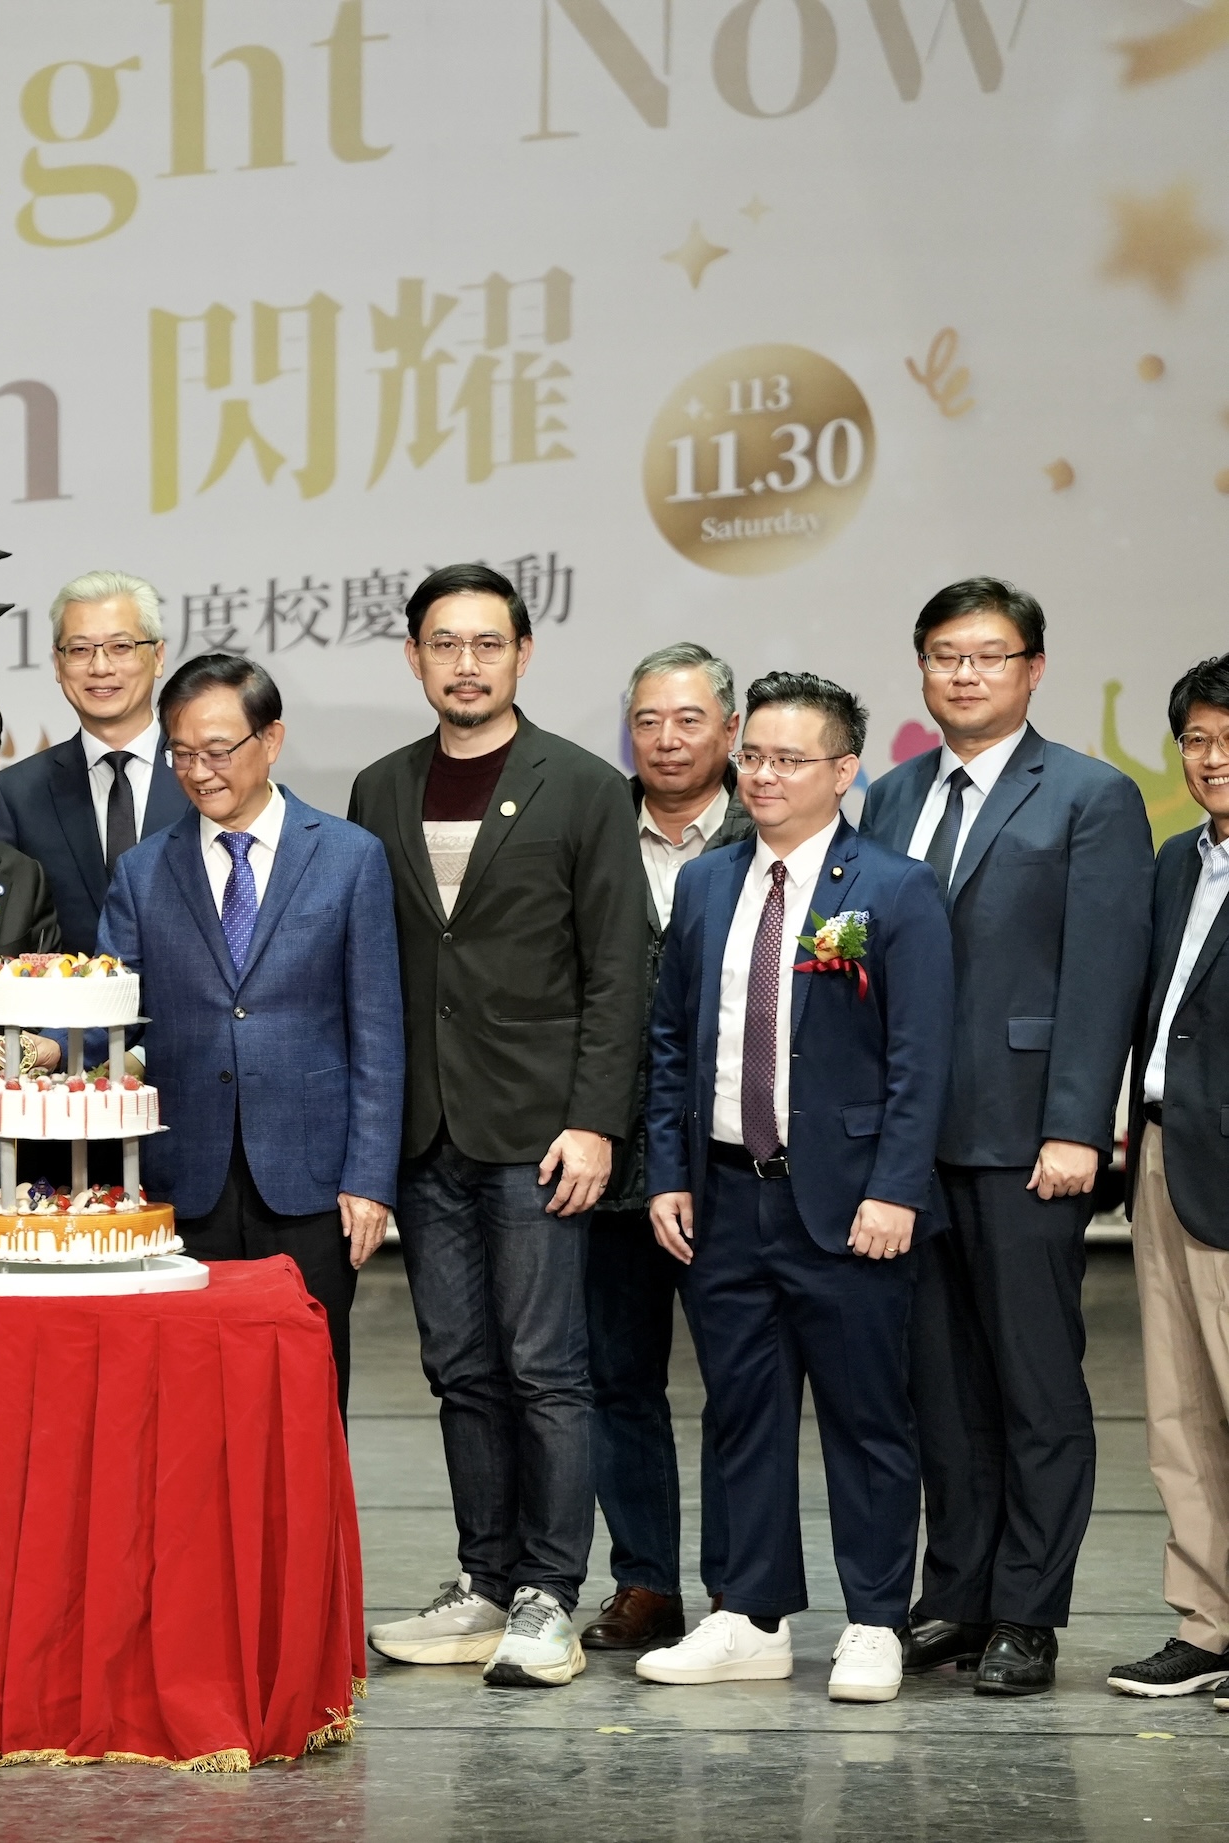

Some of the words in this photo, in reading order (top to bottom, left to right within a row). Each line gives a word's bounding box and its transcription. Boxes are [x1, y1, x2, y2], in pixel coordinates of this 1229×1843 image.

[149, 265, 576, 515] 閃耀
[726, 374, 792, 415] 113
[664, 417, 864, 504] 11.30
[700, 508, 823, 543] Saturday
